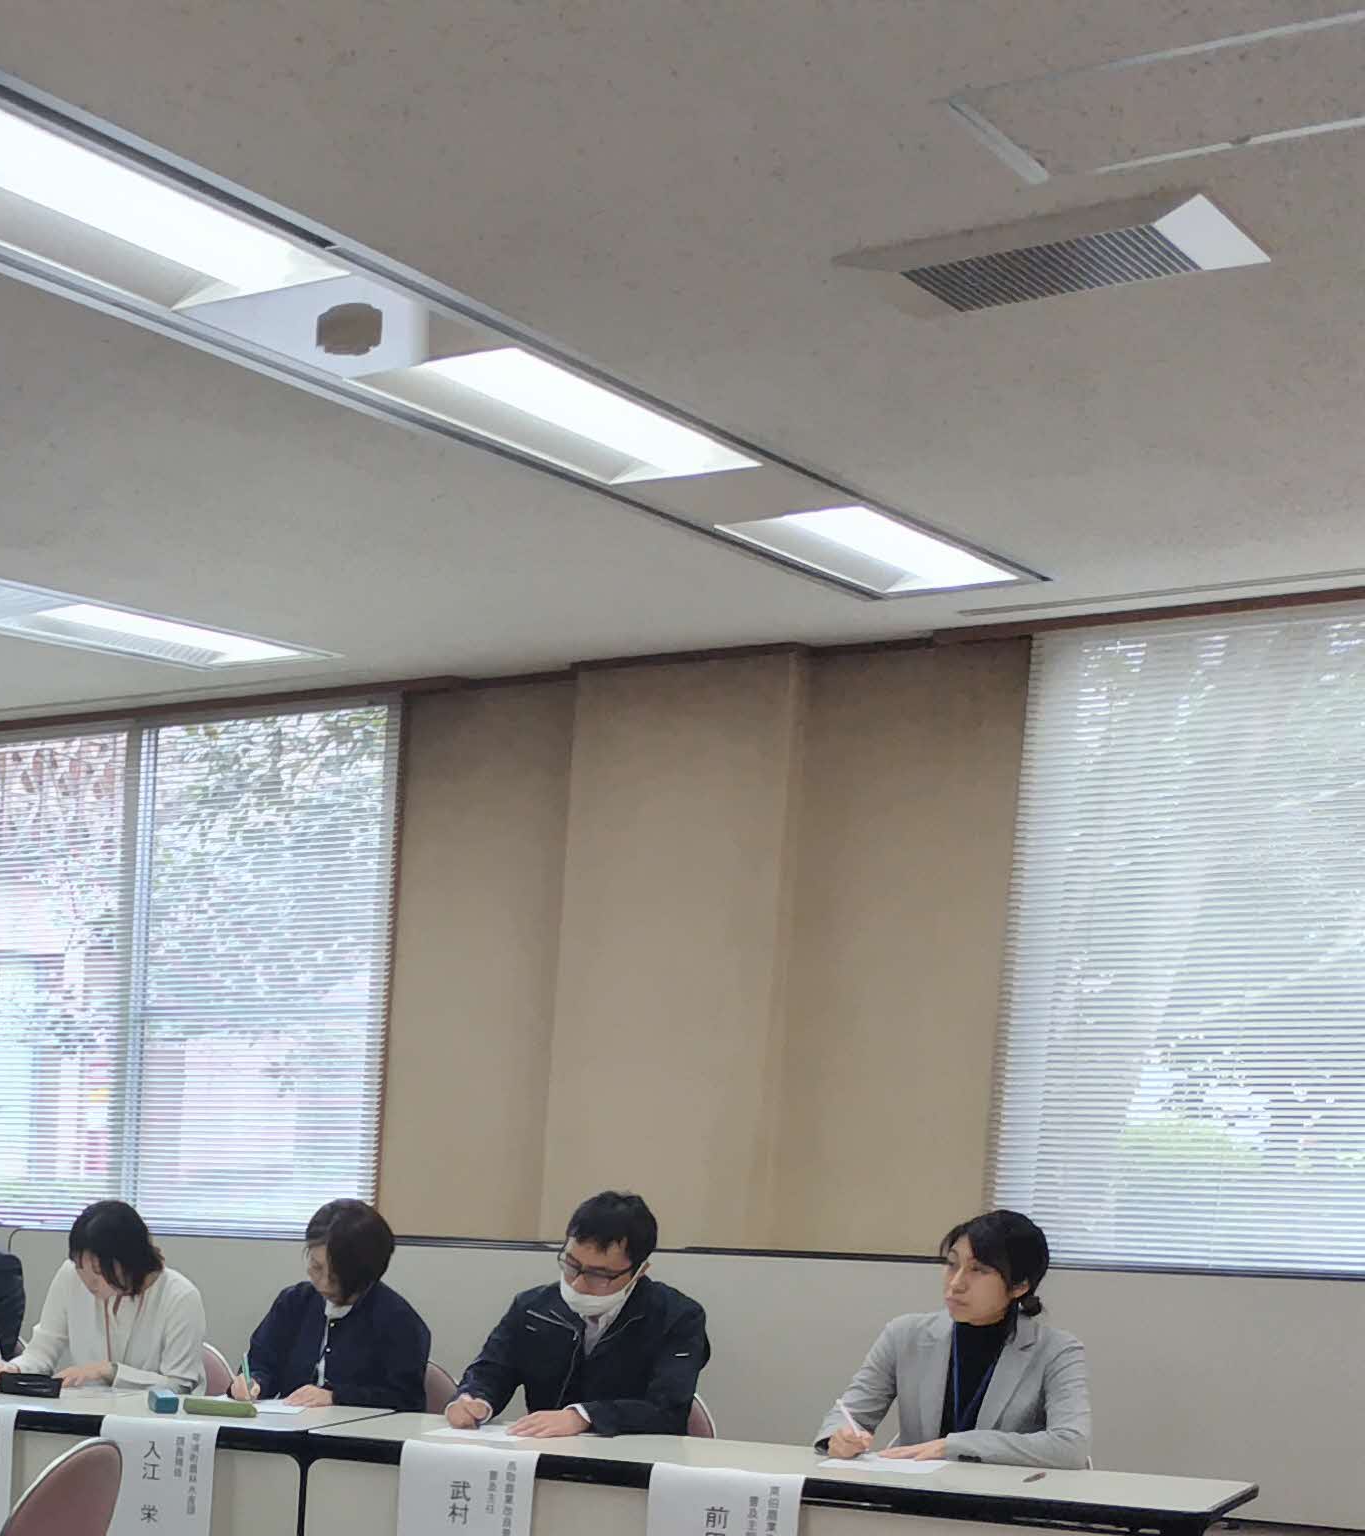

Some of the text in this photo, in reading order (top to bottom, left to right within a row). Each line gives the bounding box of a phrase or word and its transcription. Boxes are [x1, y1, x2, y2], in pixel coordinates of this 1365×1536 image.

[140, 1440, 162, 1524] 入江 栄
[447, 1480, 472, 1525] 武村
